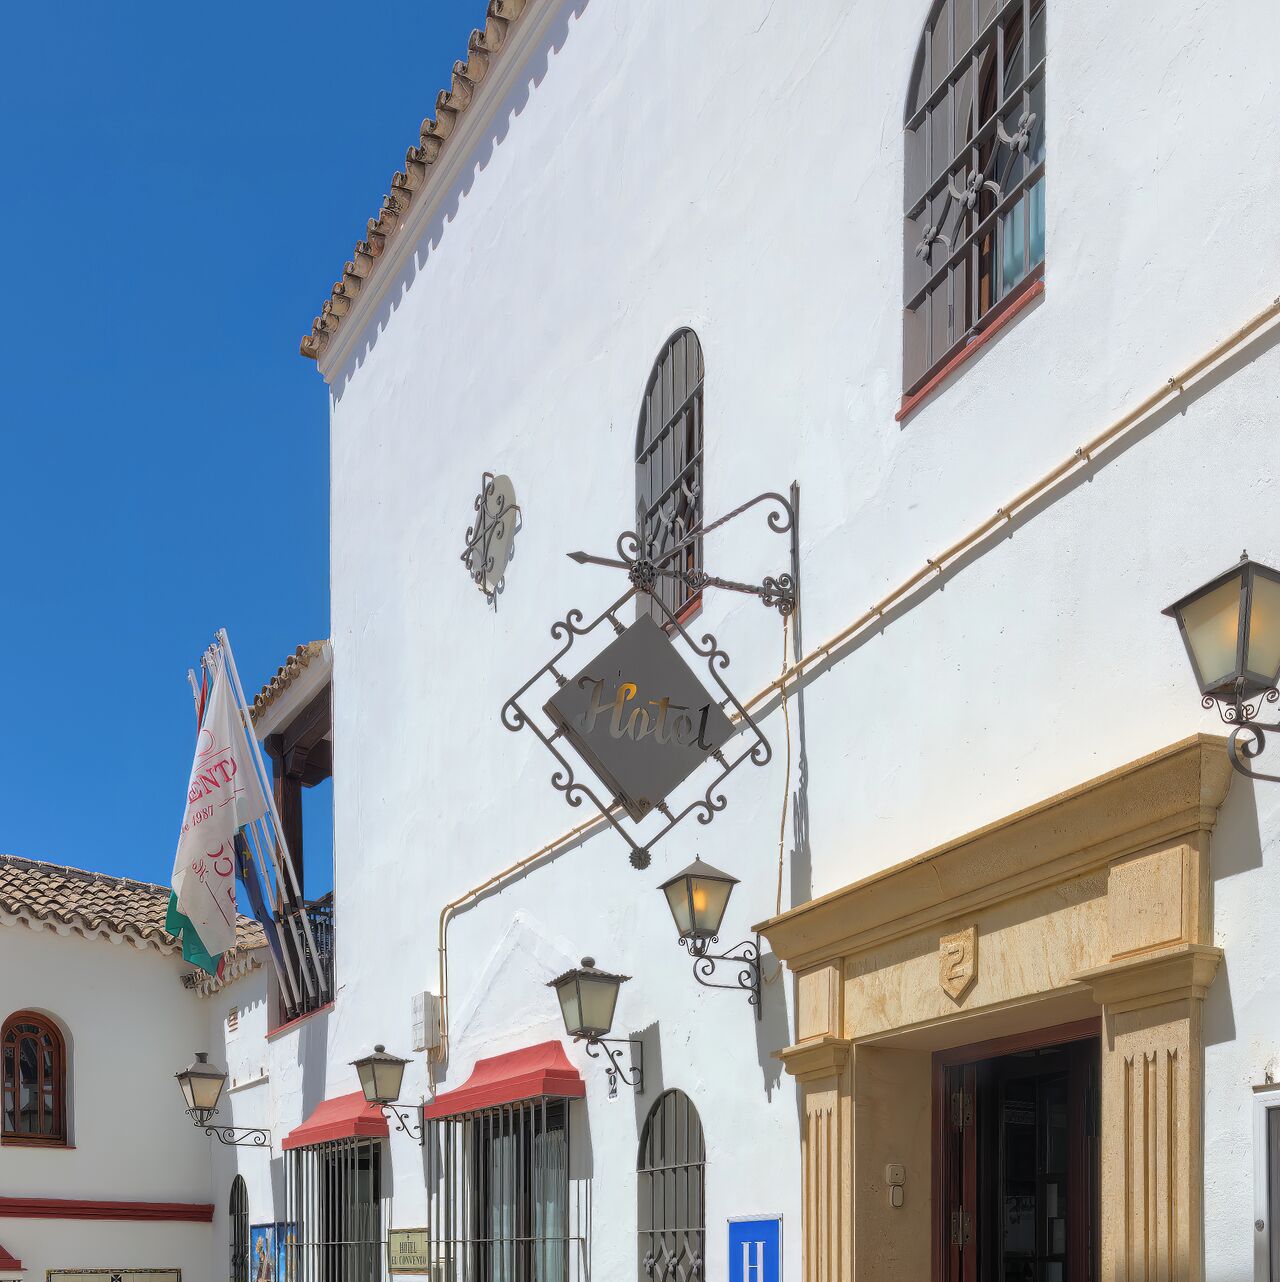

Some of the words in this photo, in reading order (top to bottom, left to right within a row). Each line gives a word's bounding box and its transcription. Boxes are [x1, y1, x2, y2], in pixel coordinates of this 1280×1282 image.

[574, 675, 713, 751] Hotel
[608, 1074, 618, 1095] 2
[399, 1241, 418, 1254] HOTEL
